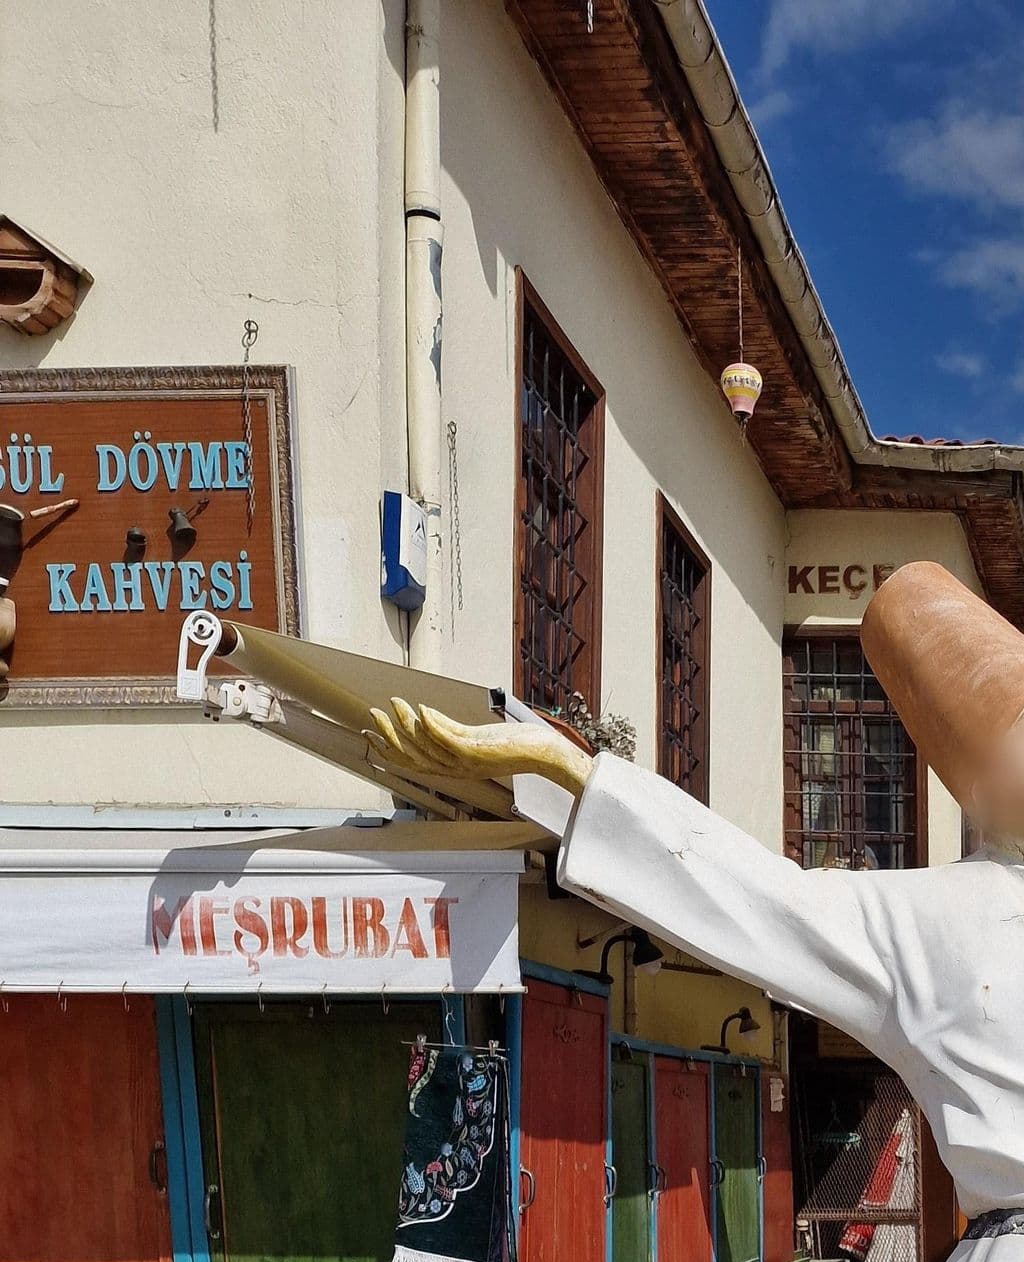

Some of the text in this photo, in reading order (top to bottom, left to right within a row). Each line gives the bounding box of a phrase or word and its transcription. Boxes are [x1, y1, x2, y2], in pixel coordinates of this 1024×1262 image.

[0, 430, 250, 493] ÜL DÖVME
[46, 550, 254, 611] KAHVESİ
[151, 895, 459, 976] MEŞRUBAT
